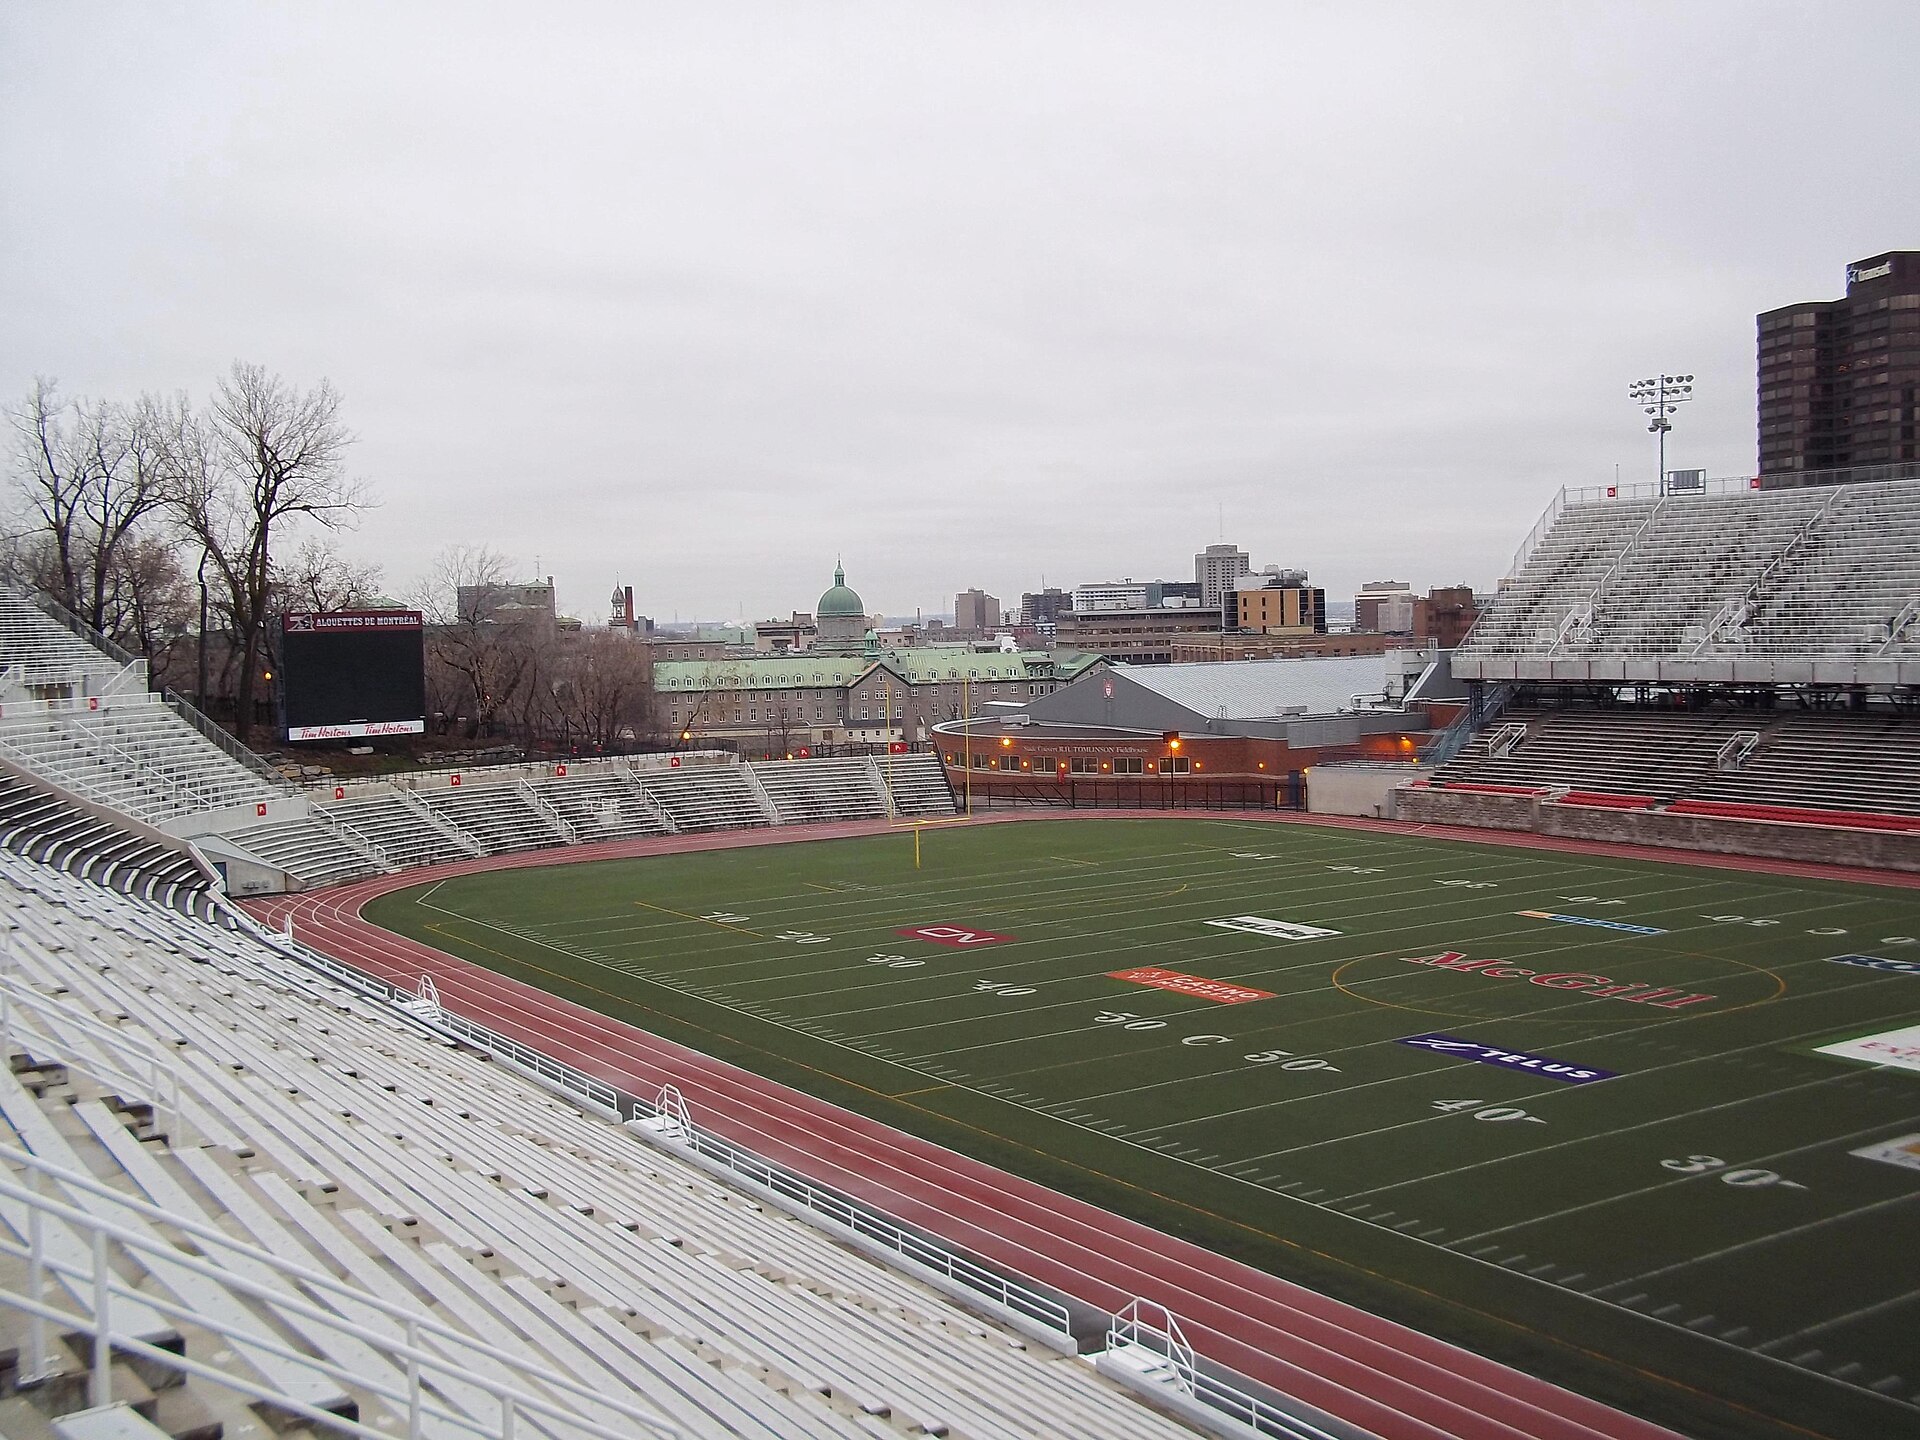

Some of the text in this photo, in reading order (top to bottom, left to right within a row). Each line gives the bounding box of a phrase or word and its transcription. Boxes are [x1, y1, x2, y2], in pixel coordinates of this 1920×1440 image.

[316, 616, 363, 627] ALOUETTES
[365, 617, 376, 626] DE
[301, 726, 352, 739] Tim Hortons
[365, 722, 414, 735] Tim Hortons
[917, 927, 995, 943] CN
[867, 953, 926, 969] 30
[973, 979, 1037, 997] 40
[1173, 976, 1260, 1001] CASINO
[1399, 951, 1718, 1010] McGill
[1094, 1010, 1167, 1031] 50
[1181, 1034, 1233, 1047] C
[1244, 1050, 1326, 1072] 50
[1480, 1048, 1598, 1080] TELUS
[1431, 1098, 1527, 1122] 40
[1660, 1154, 1782, 1187] 30
